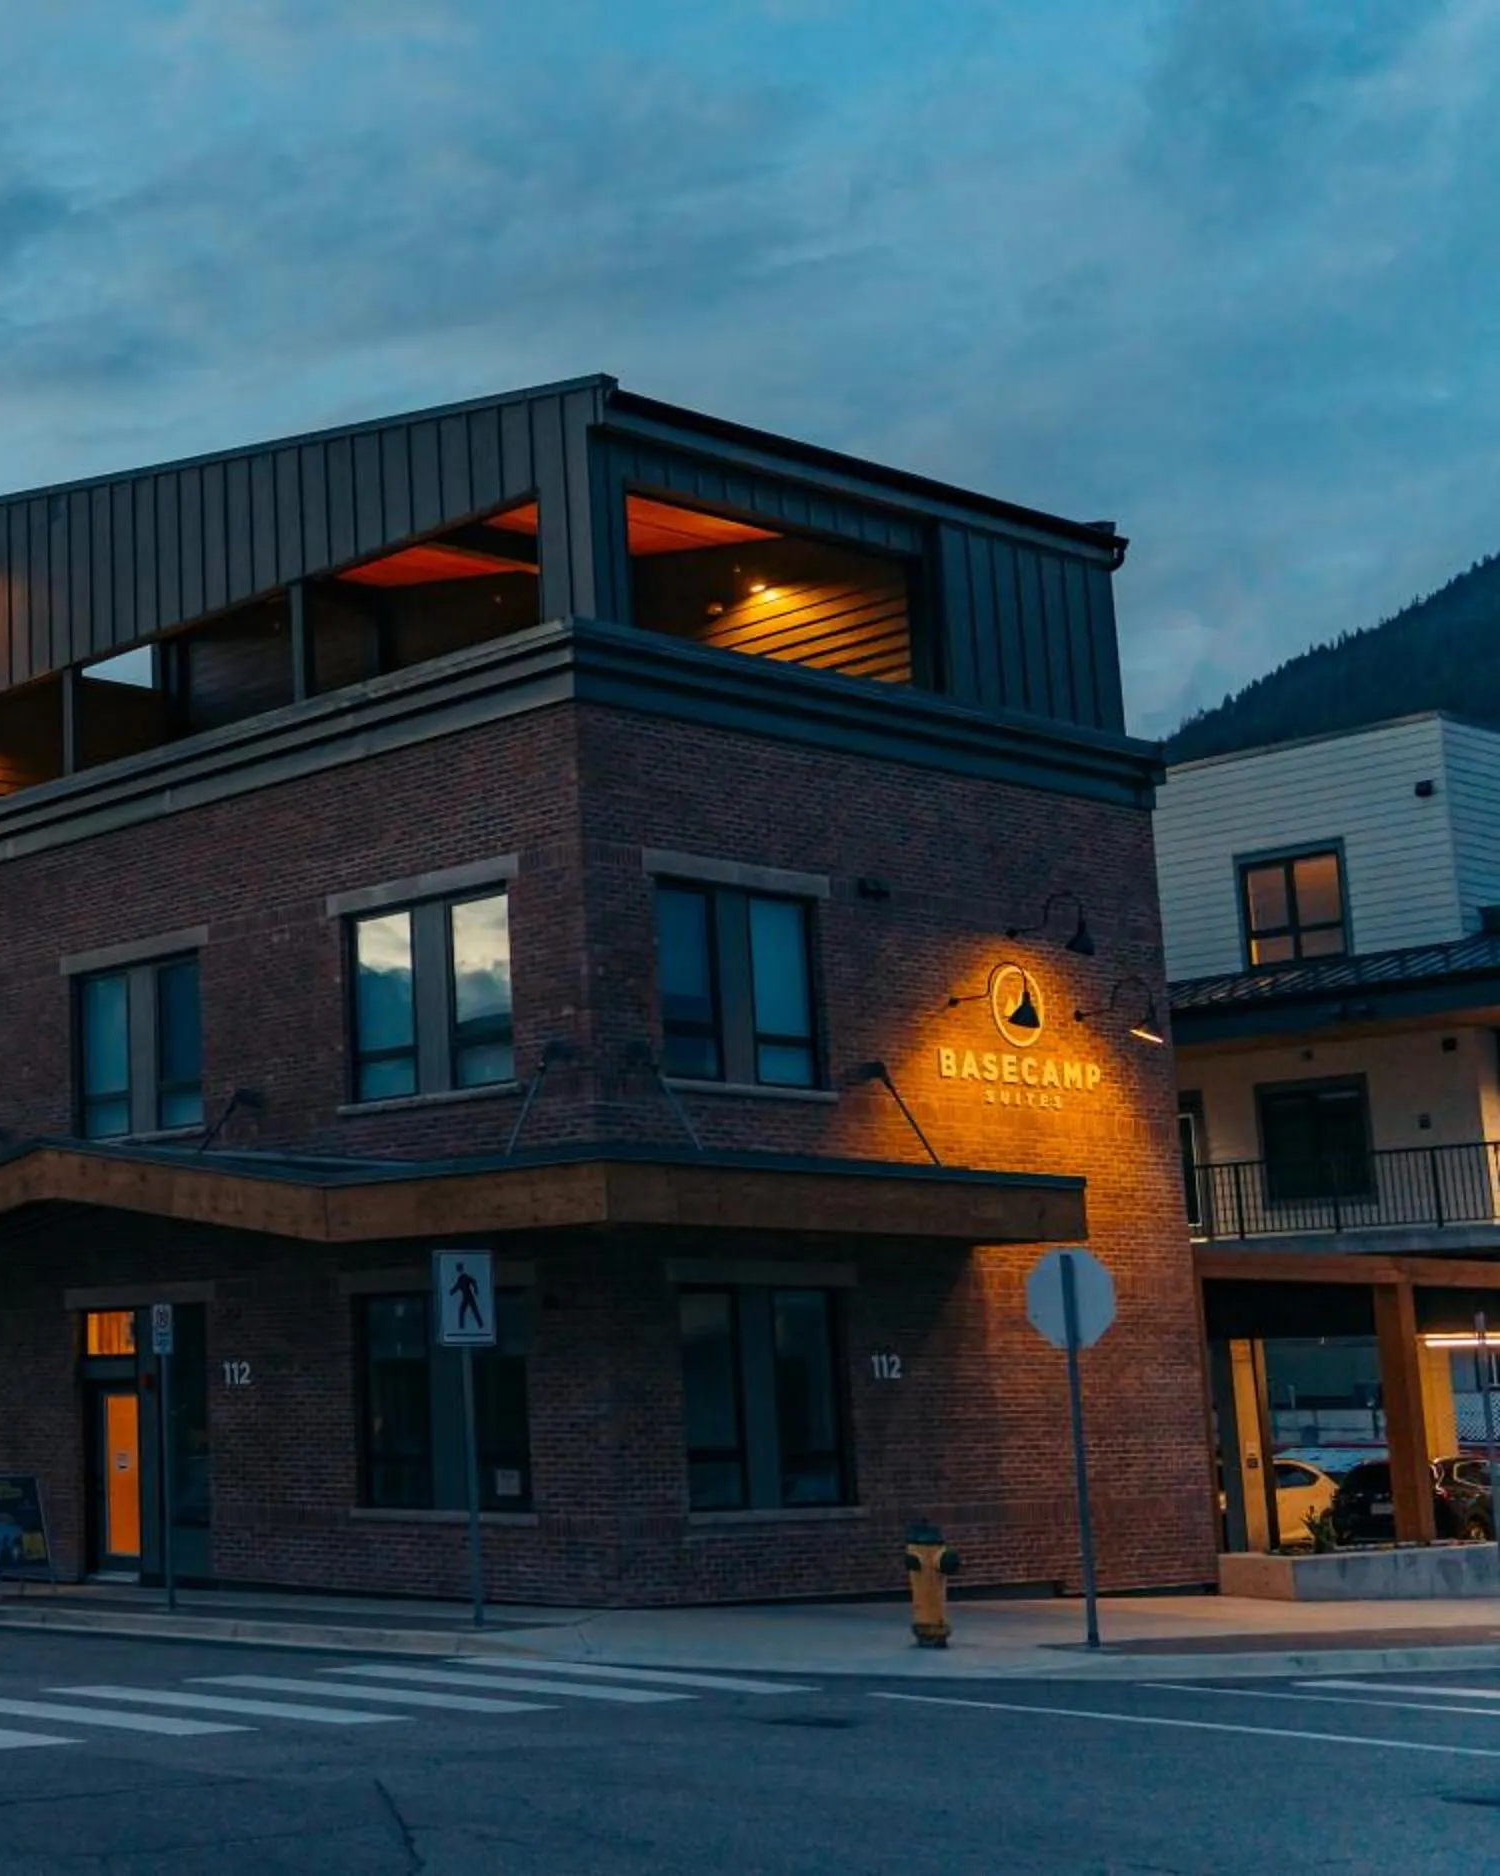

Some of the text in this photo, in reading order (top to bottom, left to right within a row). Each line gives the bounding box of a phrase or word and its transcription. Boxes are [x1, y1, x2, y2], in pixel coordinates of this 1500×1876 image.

[939, 1047, 1101, 1090] BASECAMP
[984, 1088, 1062, 1109] SUITES
[222, 1361, 251, 1385] 112
[871, 1354, 901, 1379] 112
